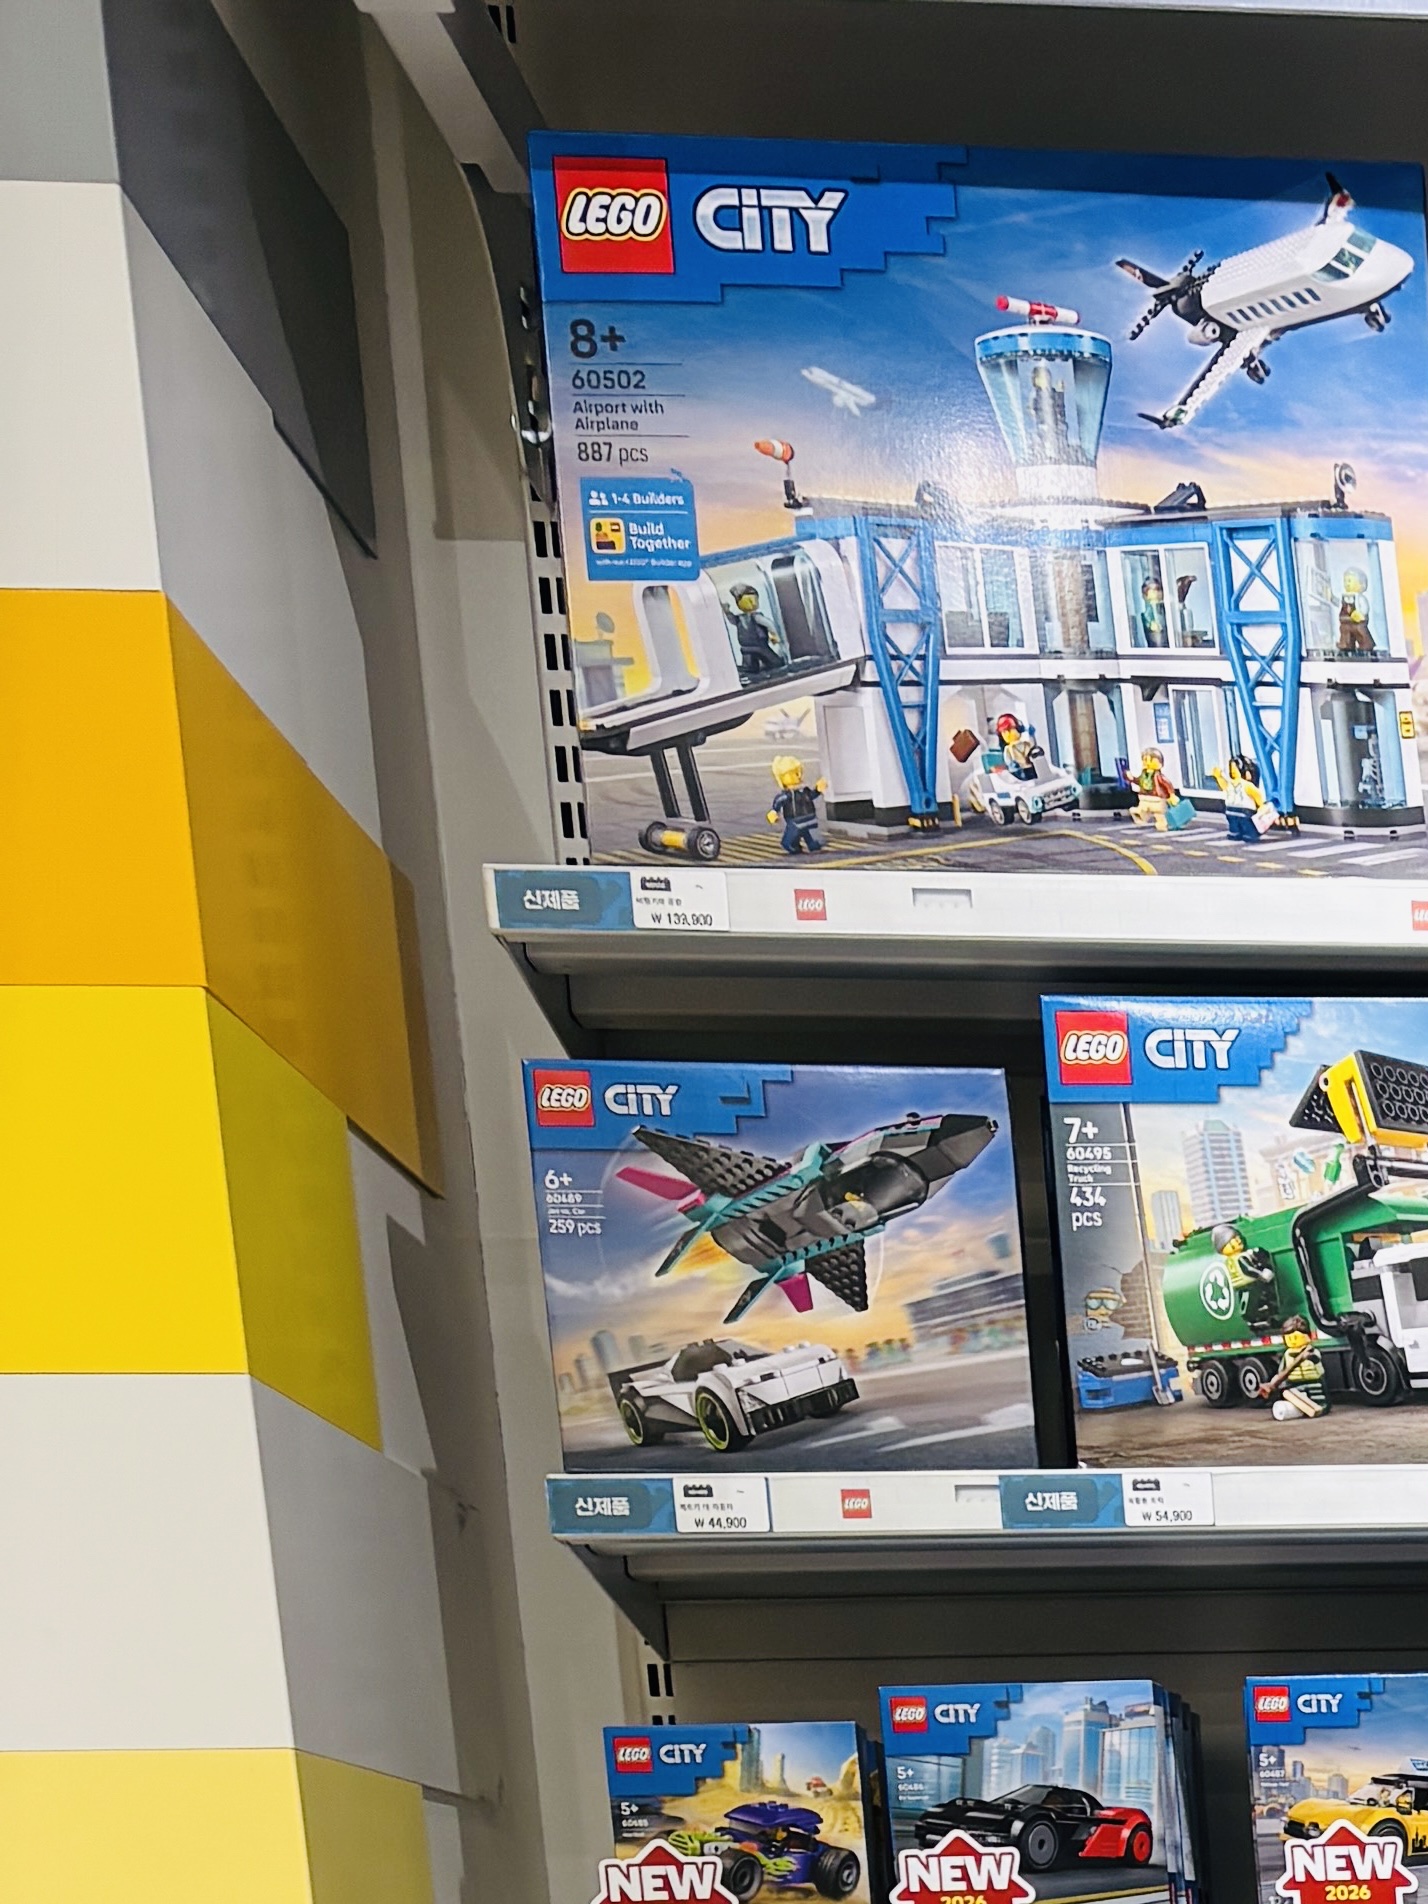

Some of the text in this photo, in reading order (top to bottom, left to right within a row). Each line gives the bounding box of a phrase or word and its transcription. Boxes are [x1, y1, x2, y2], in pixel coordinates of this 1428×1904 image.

[570, 319, 626, 358] 8+
[572, 370, 646, 390] 60502
[573, 401, 664, 418] Airport with
[575, 417, 638, 433] Airplane
[578, 442, 648, 466] 887 pcs
[629, 522, 664, 537] Build
[629, 536, 690, 552] Together
[1061, 1028, 1240, 1070] LEGO CITY
[1064, 1118, 1099, 1143] 7+
[1066, 1147, 1112, 1160] 60495
[1067, 1163, 1112, 1176] Recycling
[545, 1171, 572, 1189] 6+
[1070, 1187, 1106, 1207] 434
[549, 1219, 601, 1236] 259 pcs
[1072, 1210, 1103, 1230] pcs
[574, 1497, 630, 1516] 신제품
[1025, 1492, 1077, 1512] 신제품
[708, 1516, 747, 1530] 44,900
[1155, 1509, 1192, 1522] 54,900
[1256, 1693, 1342, 1713] LEGO CITY
[894, 1703, 980, 1724] LEGO CITY
[620, 1803, 639, 1816] 5+
[1292, 1843, 1398, 1881] NEW
[607, 1864, 717, 1902] NEW
[906, 1854, 1016, 1893] NEW
[1324, 1885, 1371, 1901] 2026
